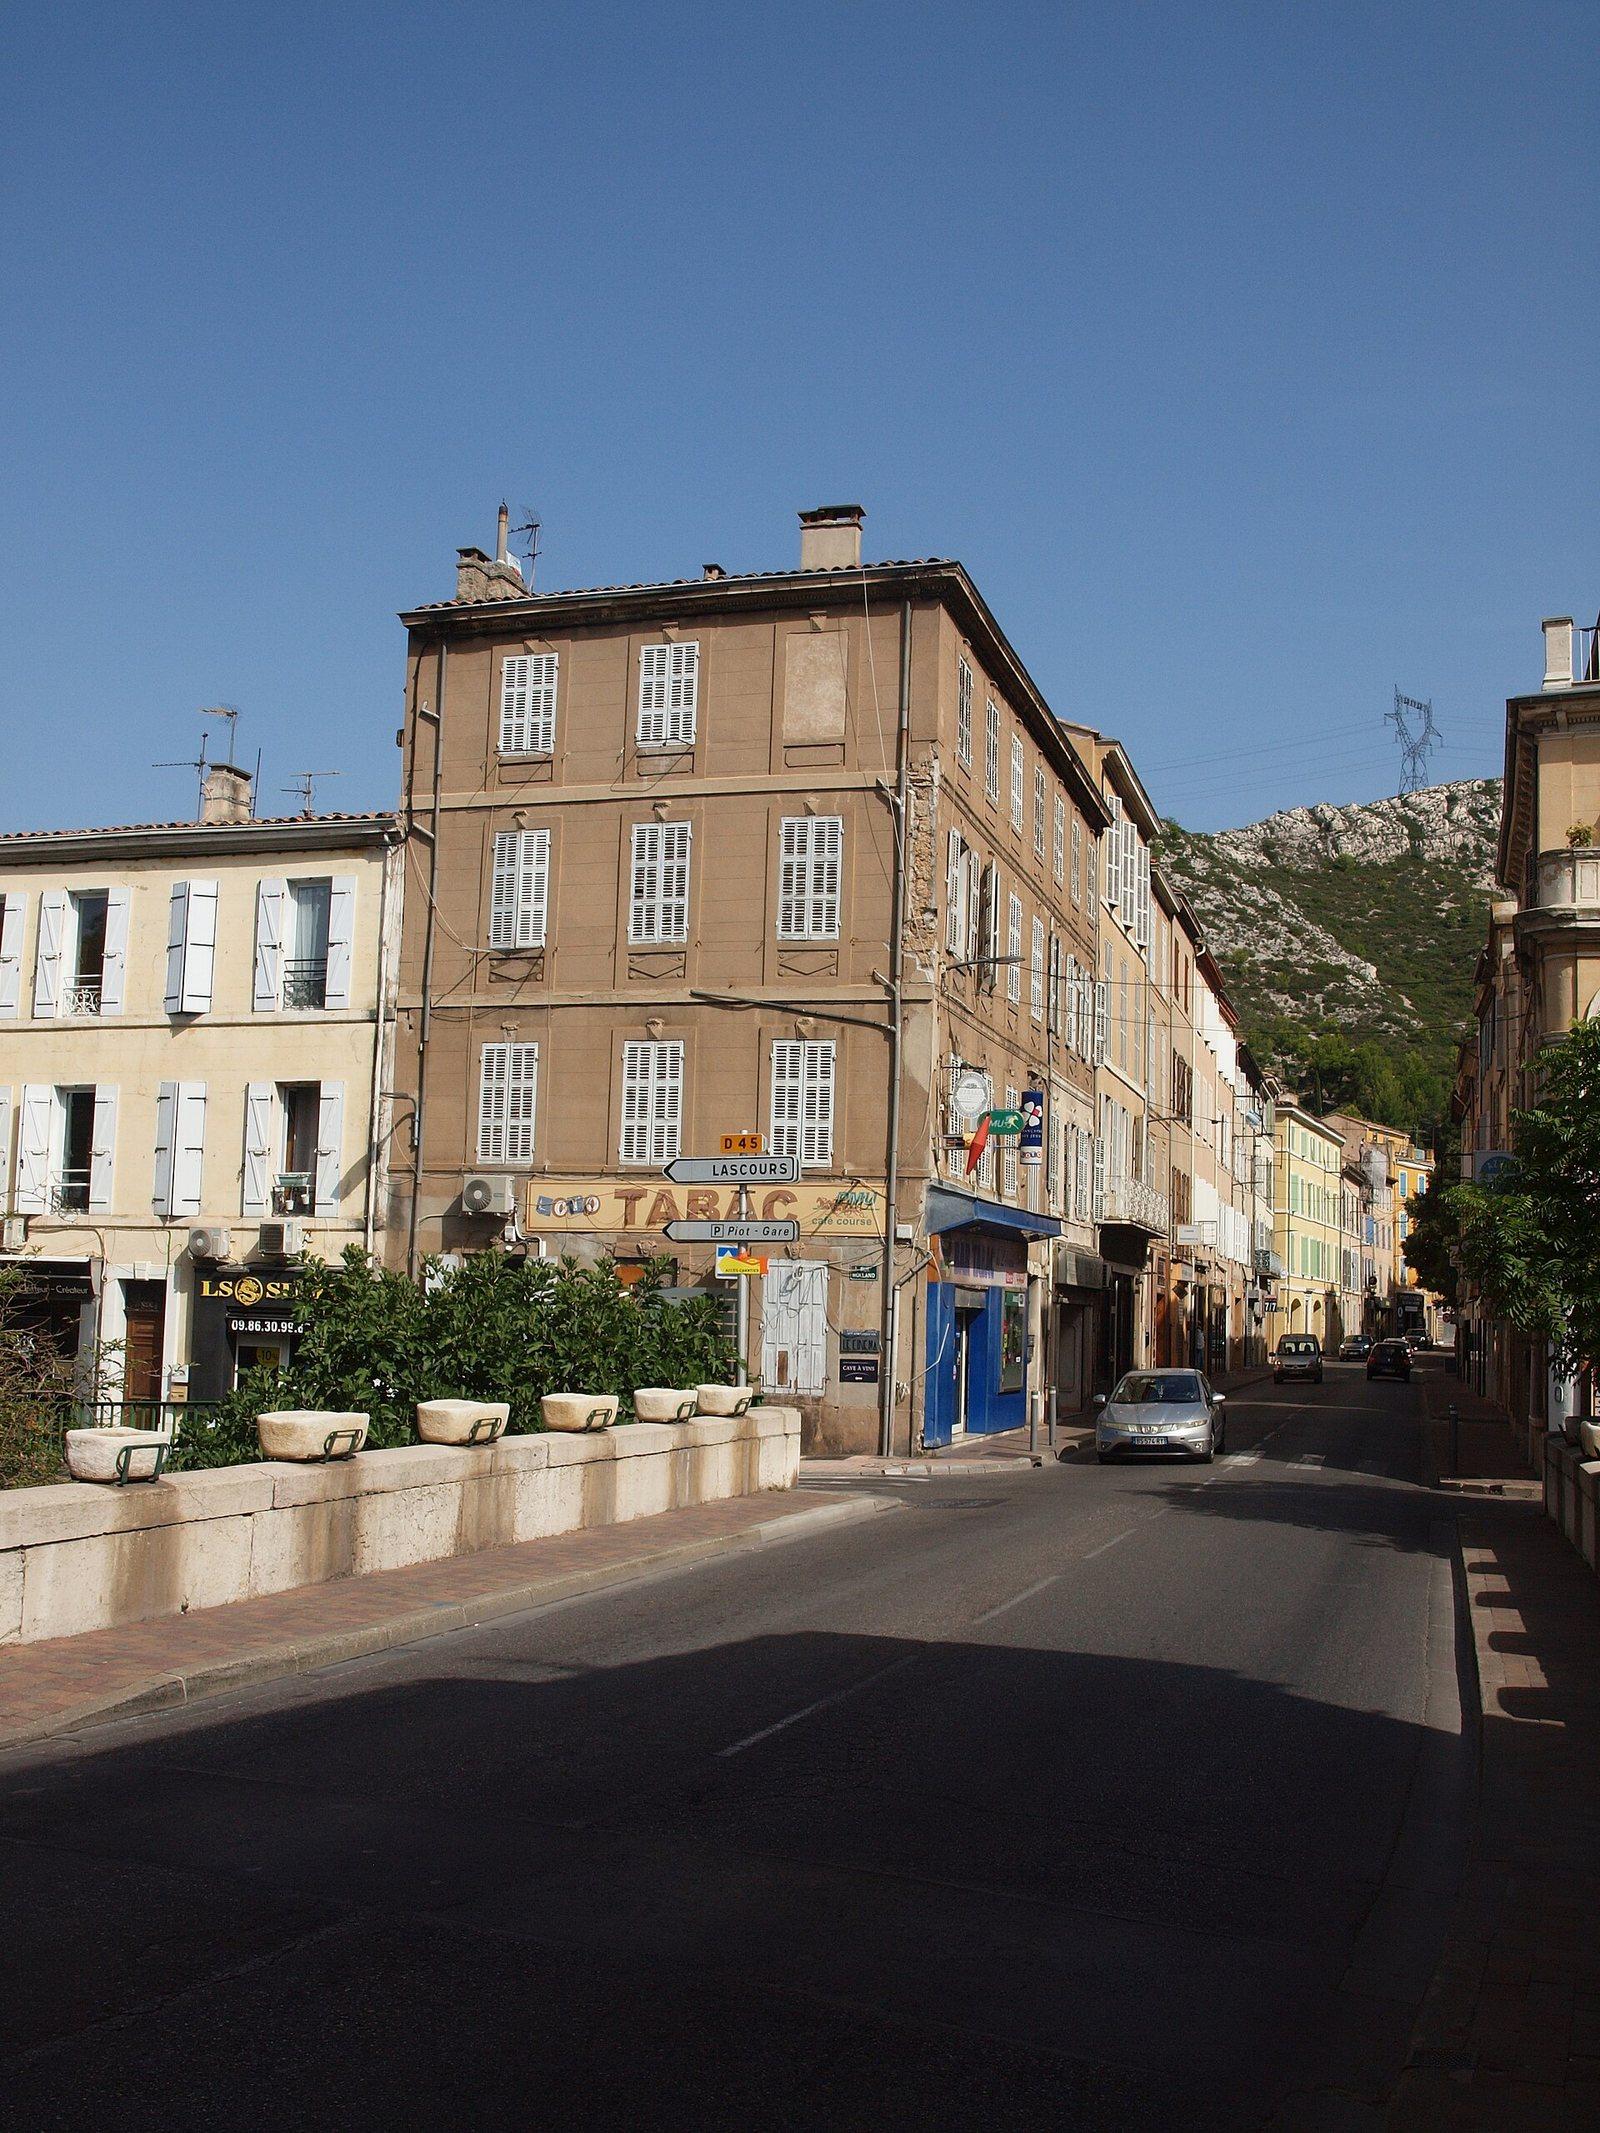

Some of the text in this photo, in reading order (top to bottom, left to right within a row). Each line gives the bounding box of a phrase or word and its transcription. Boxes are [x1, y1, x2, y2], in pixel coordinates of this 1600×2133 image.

[724, 1138, 732, 1149] D
[712, 1163, 788, 1176] LASCOURS
[836, 1191, 877, 1206] PMU
[614, 1188, 799, 1228] TABAC
[811, 1217, 873, 1226] café course
[727, 1226, 750, 1236] Piot
[762, 1226, 790, 1236] Gare
[56, 1284, 89, 1294] Créateur
[200, 1280, 233, 1297] LS
[231, 1319, 311, 1334] 09.86.30.99.8
